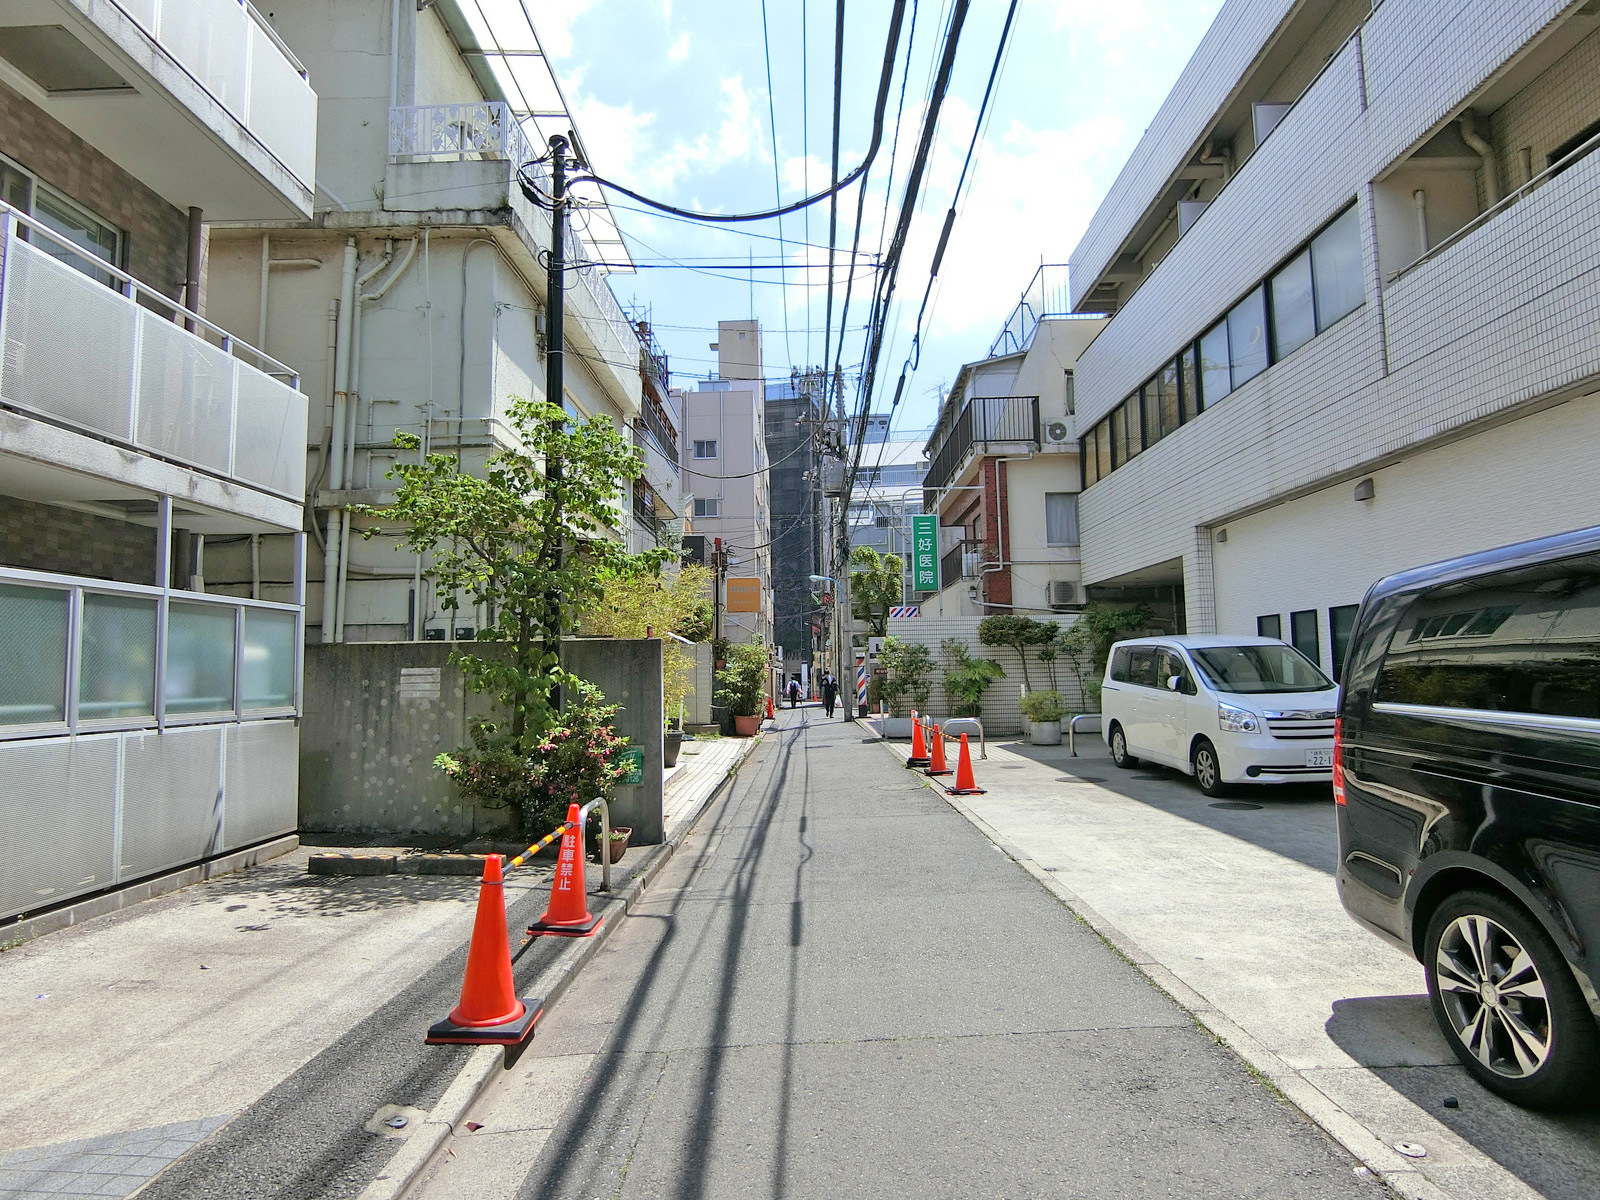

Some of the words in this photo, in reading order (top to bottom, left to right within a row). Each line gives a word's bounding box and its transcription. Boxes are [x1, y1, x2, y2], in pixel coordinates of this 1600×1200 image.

[918, 522, 934, 584] 三好医院
[559, 834, 576, 891] 駐車禁止
